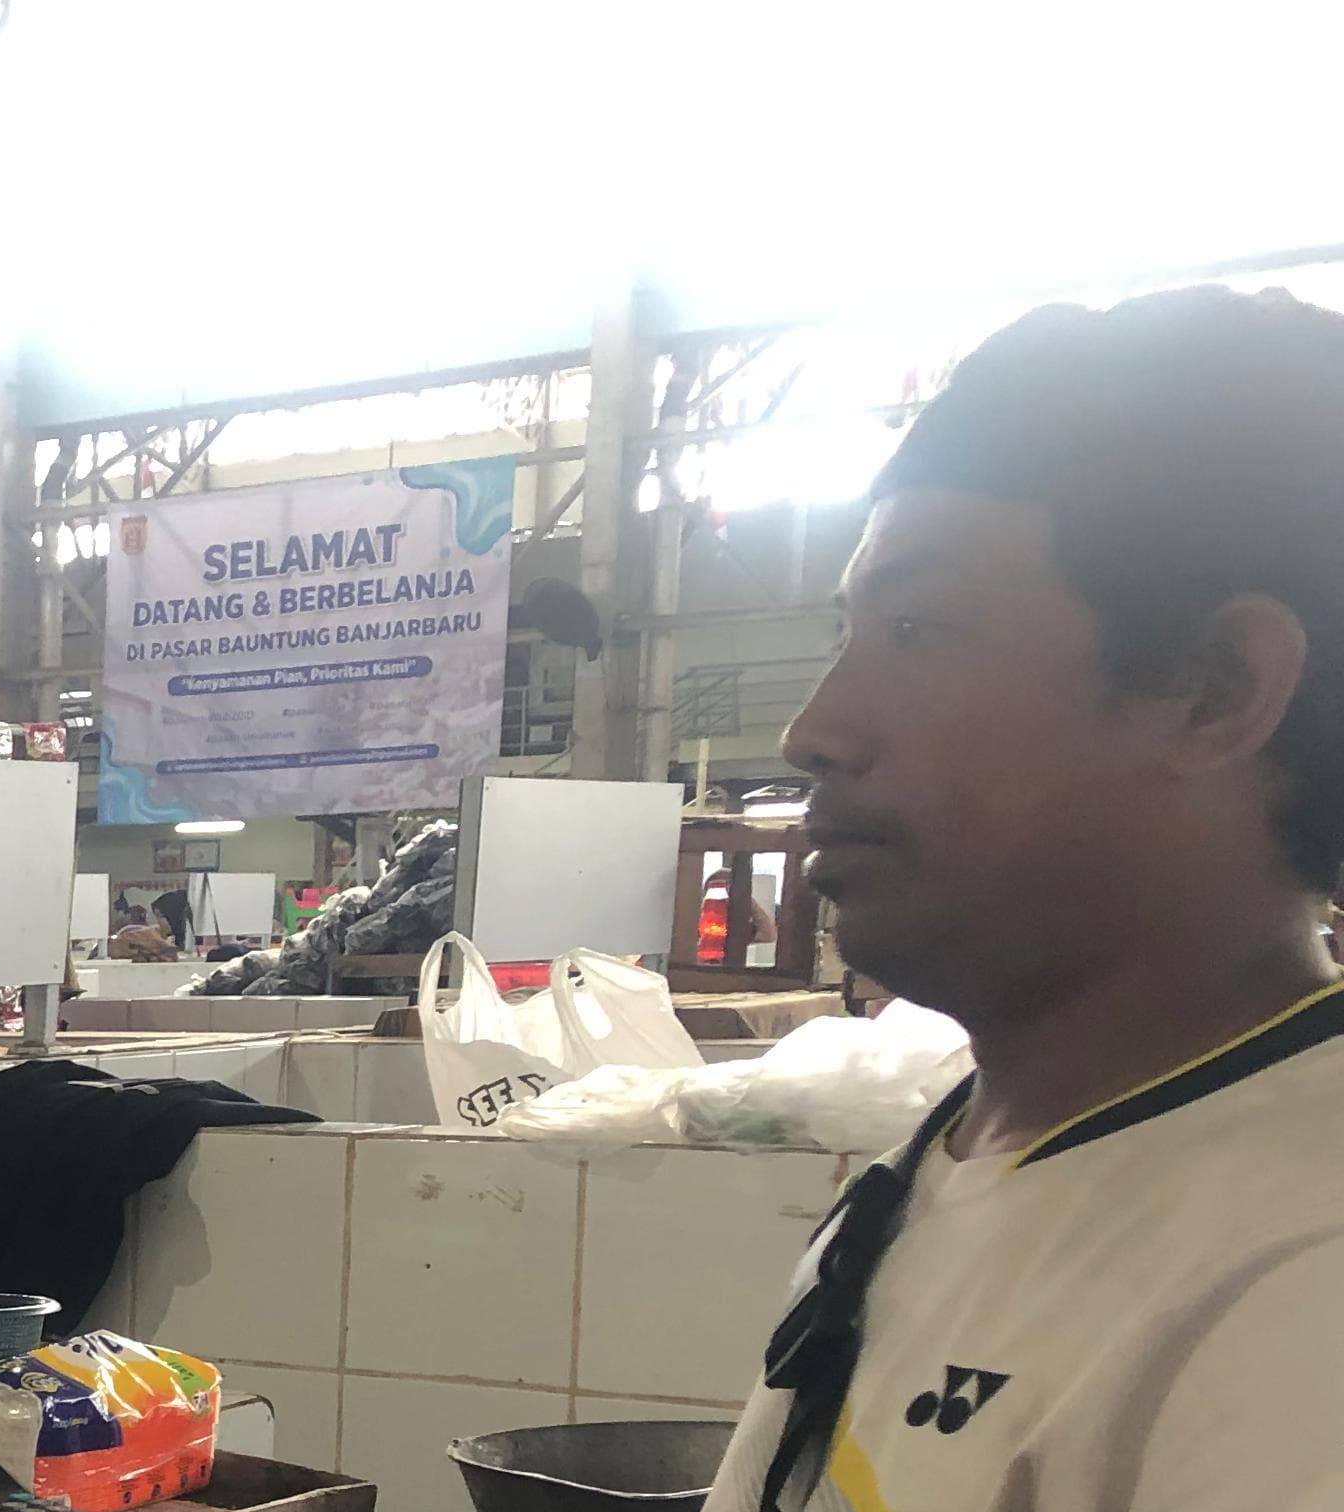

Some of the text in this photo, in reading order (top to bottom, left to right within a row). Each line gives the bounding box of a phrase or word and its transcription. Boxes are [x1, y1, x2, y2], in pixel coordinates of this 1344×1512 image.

[202, 524, 402, 581] SELAMAT
[132, 569, 475, 627] DATANG & BERBELANJA
[126, 611, 481, 662] DI PASAR BAUNTUNG BANJARBARU
[310, 665, 369, 681] Prioritas
